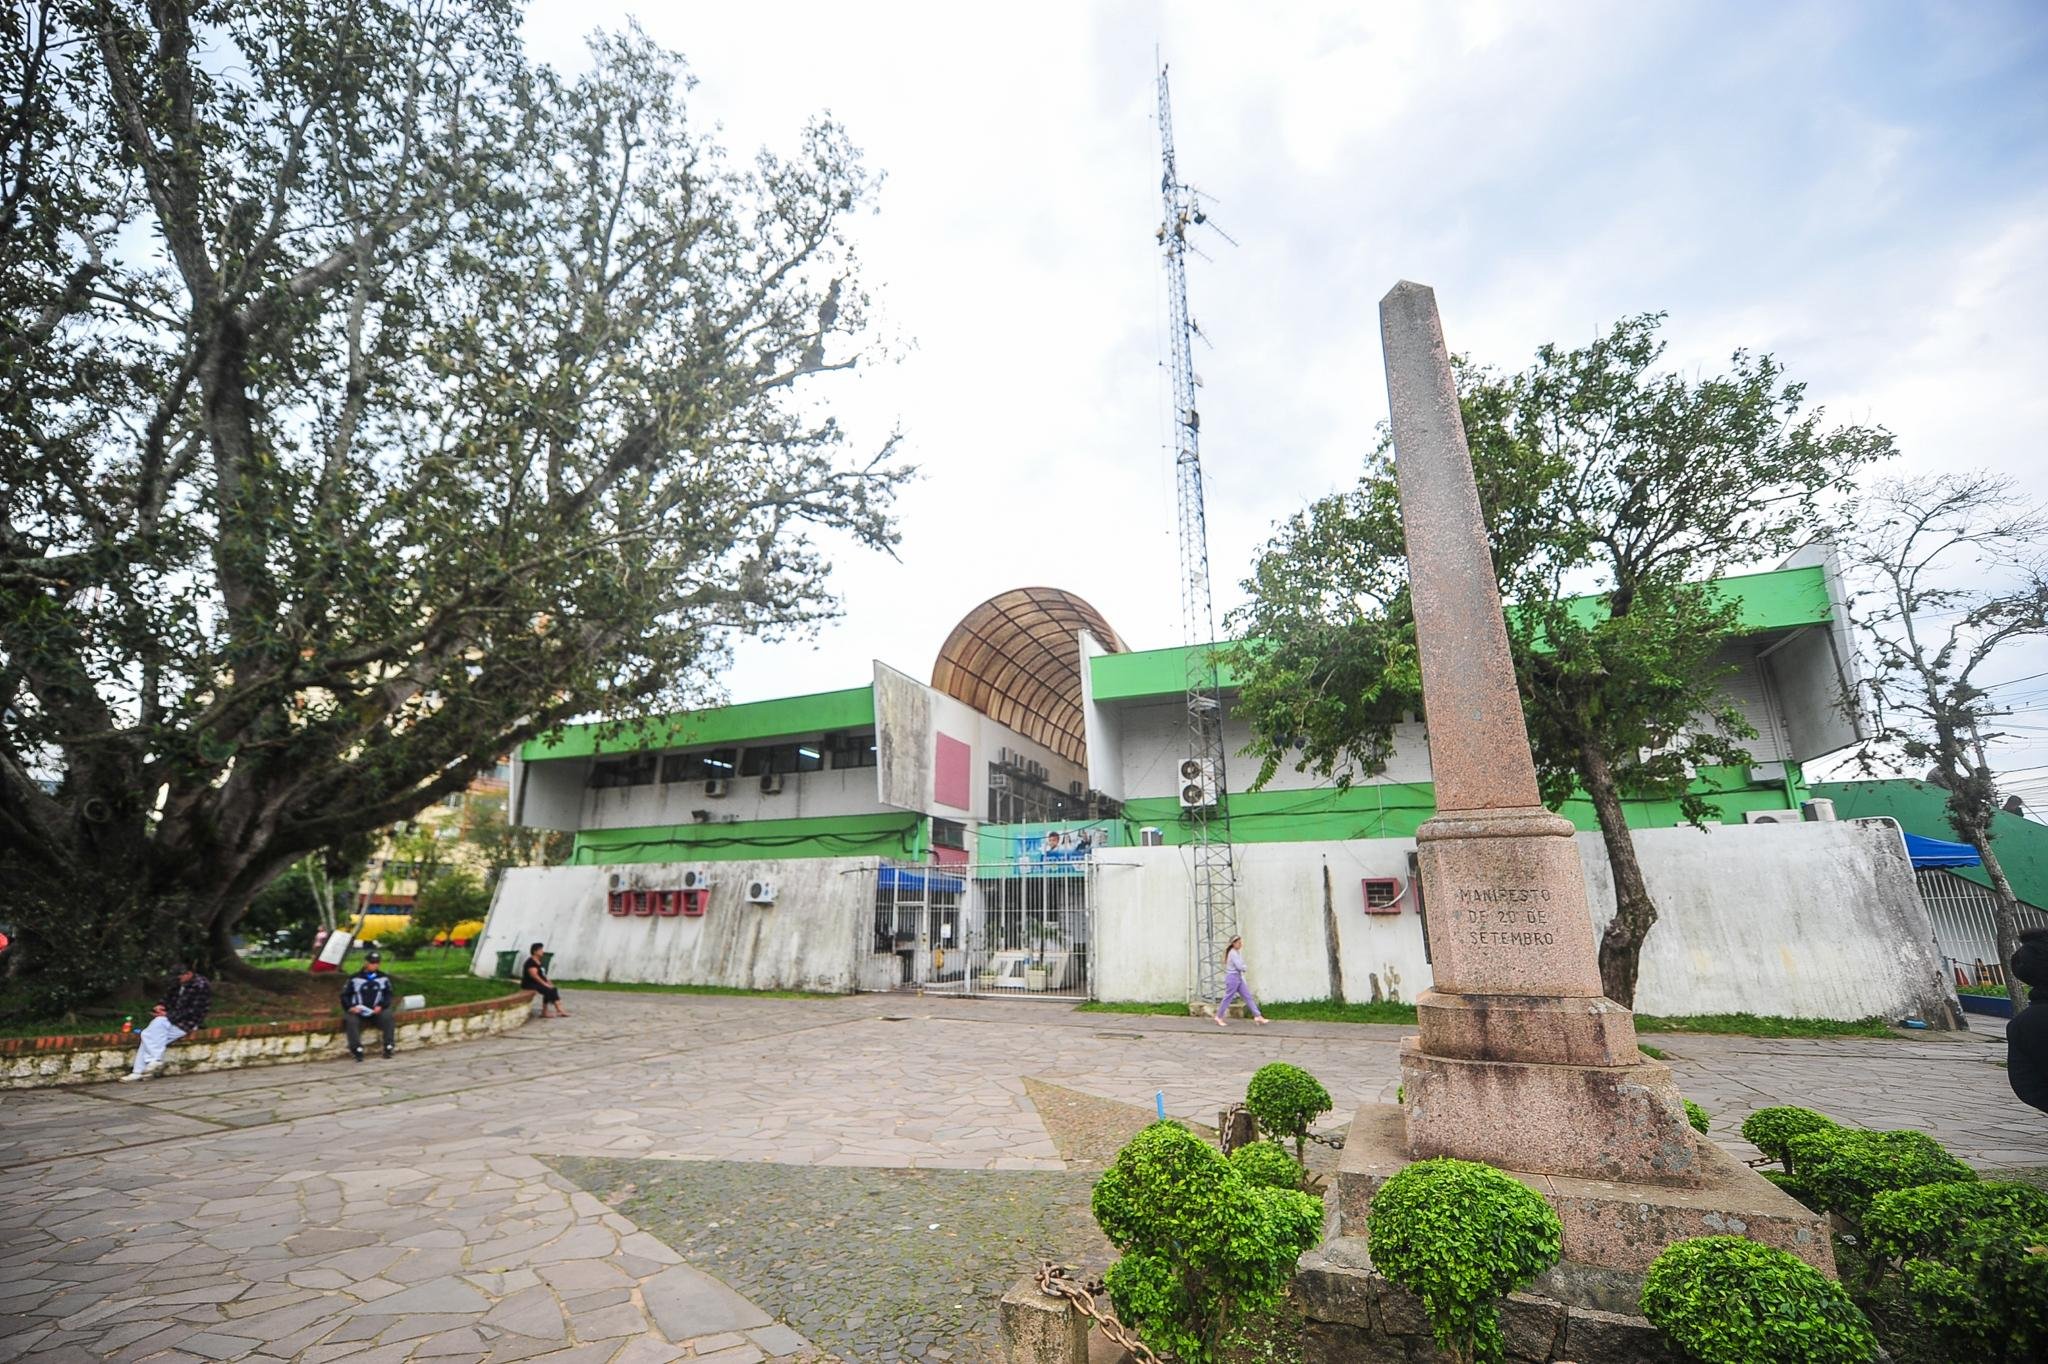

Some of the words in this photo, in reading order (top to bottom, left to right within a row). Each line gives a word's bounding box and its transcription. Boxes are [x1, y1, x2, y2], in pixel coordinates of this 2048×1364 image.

[1460, 889, 1551, 902] MANIFESTO
[1468, 910, 1486, 923] DE
[1498, 910, 1516, 923] 20
[1527, 910, 1547, 924] DE
[1470, 931, 1553, 945] SETEMBRO
